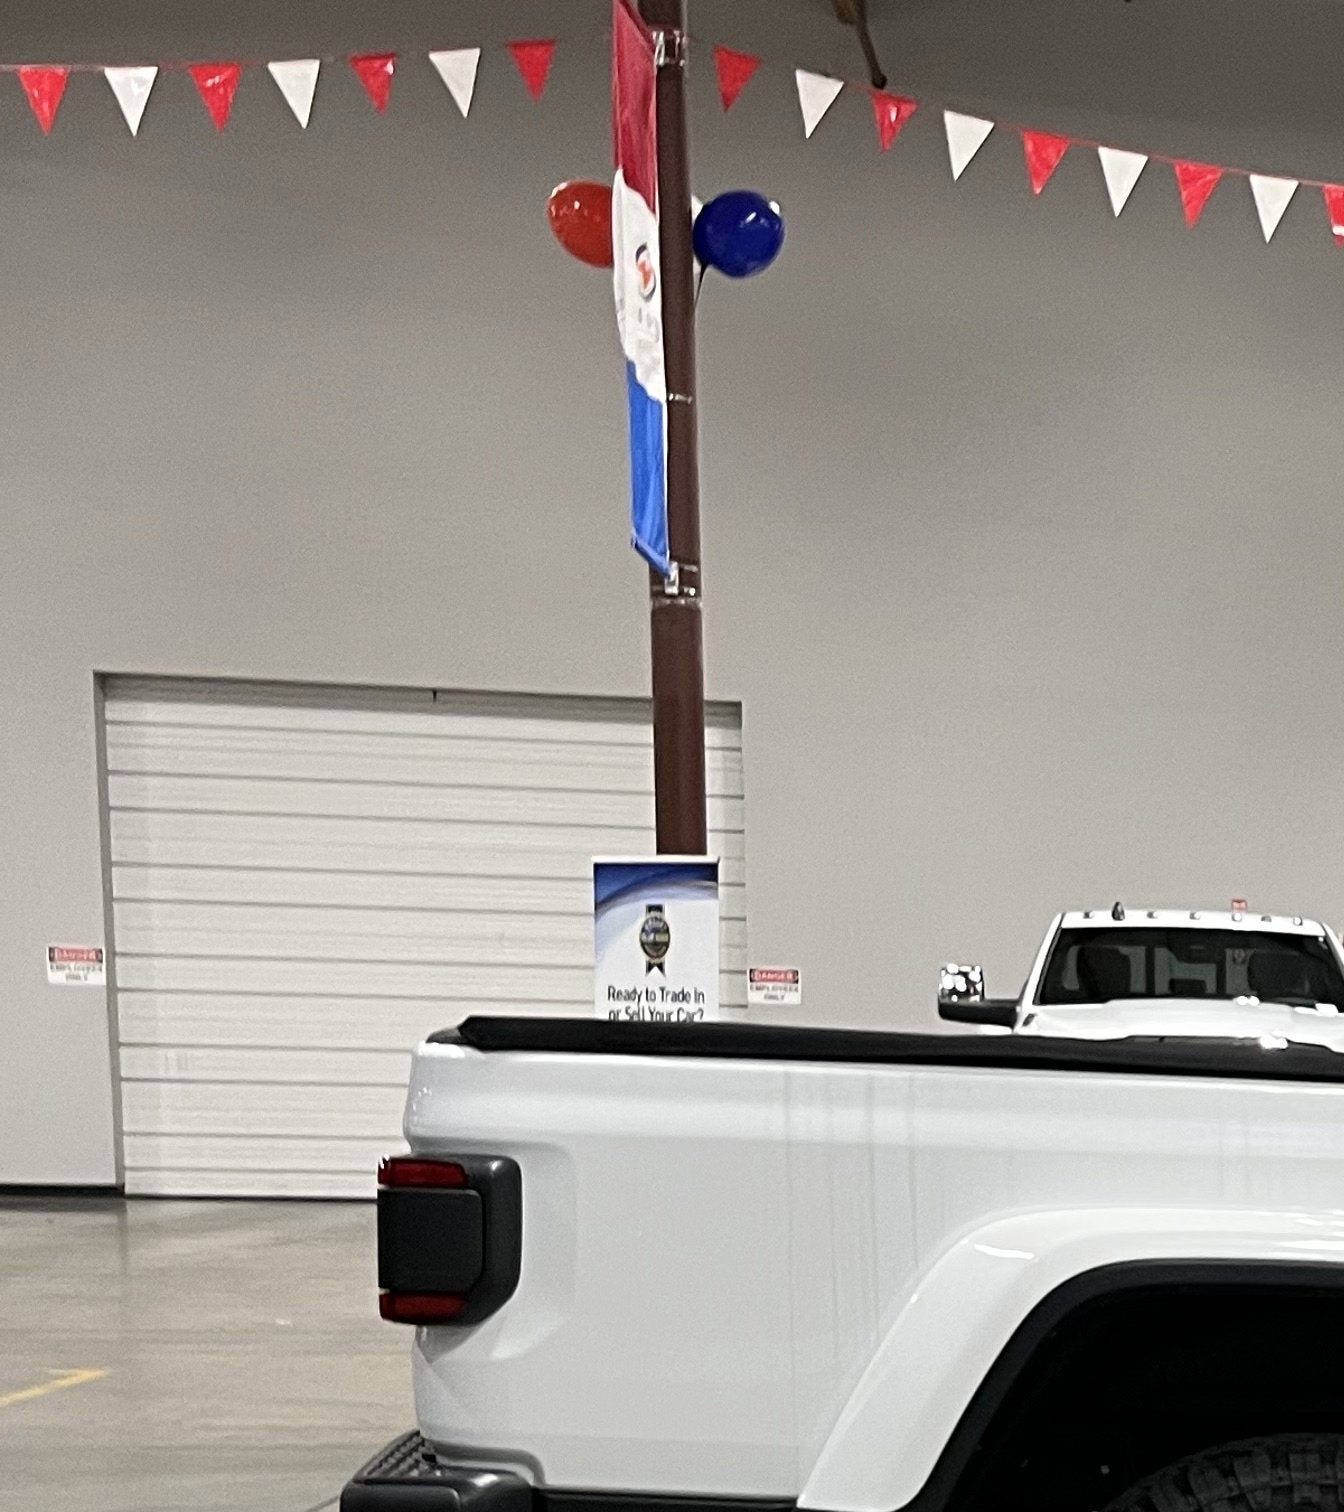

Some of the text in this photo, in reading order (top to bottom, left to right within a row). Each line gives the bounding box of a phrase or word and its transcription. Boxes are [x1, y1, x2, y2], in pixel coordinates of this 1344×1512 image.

[608, 985, 705, 1004] Ready to Trade In
[648, 1006, 673, 1021] Your
